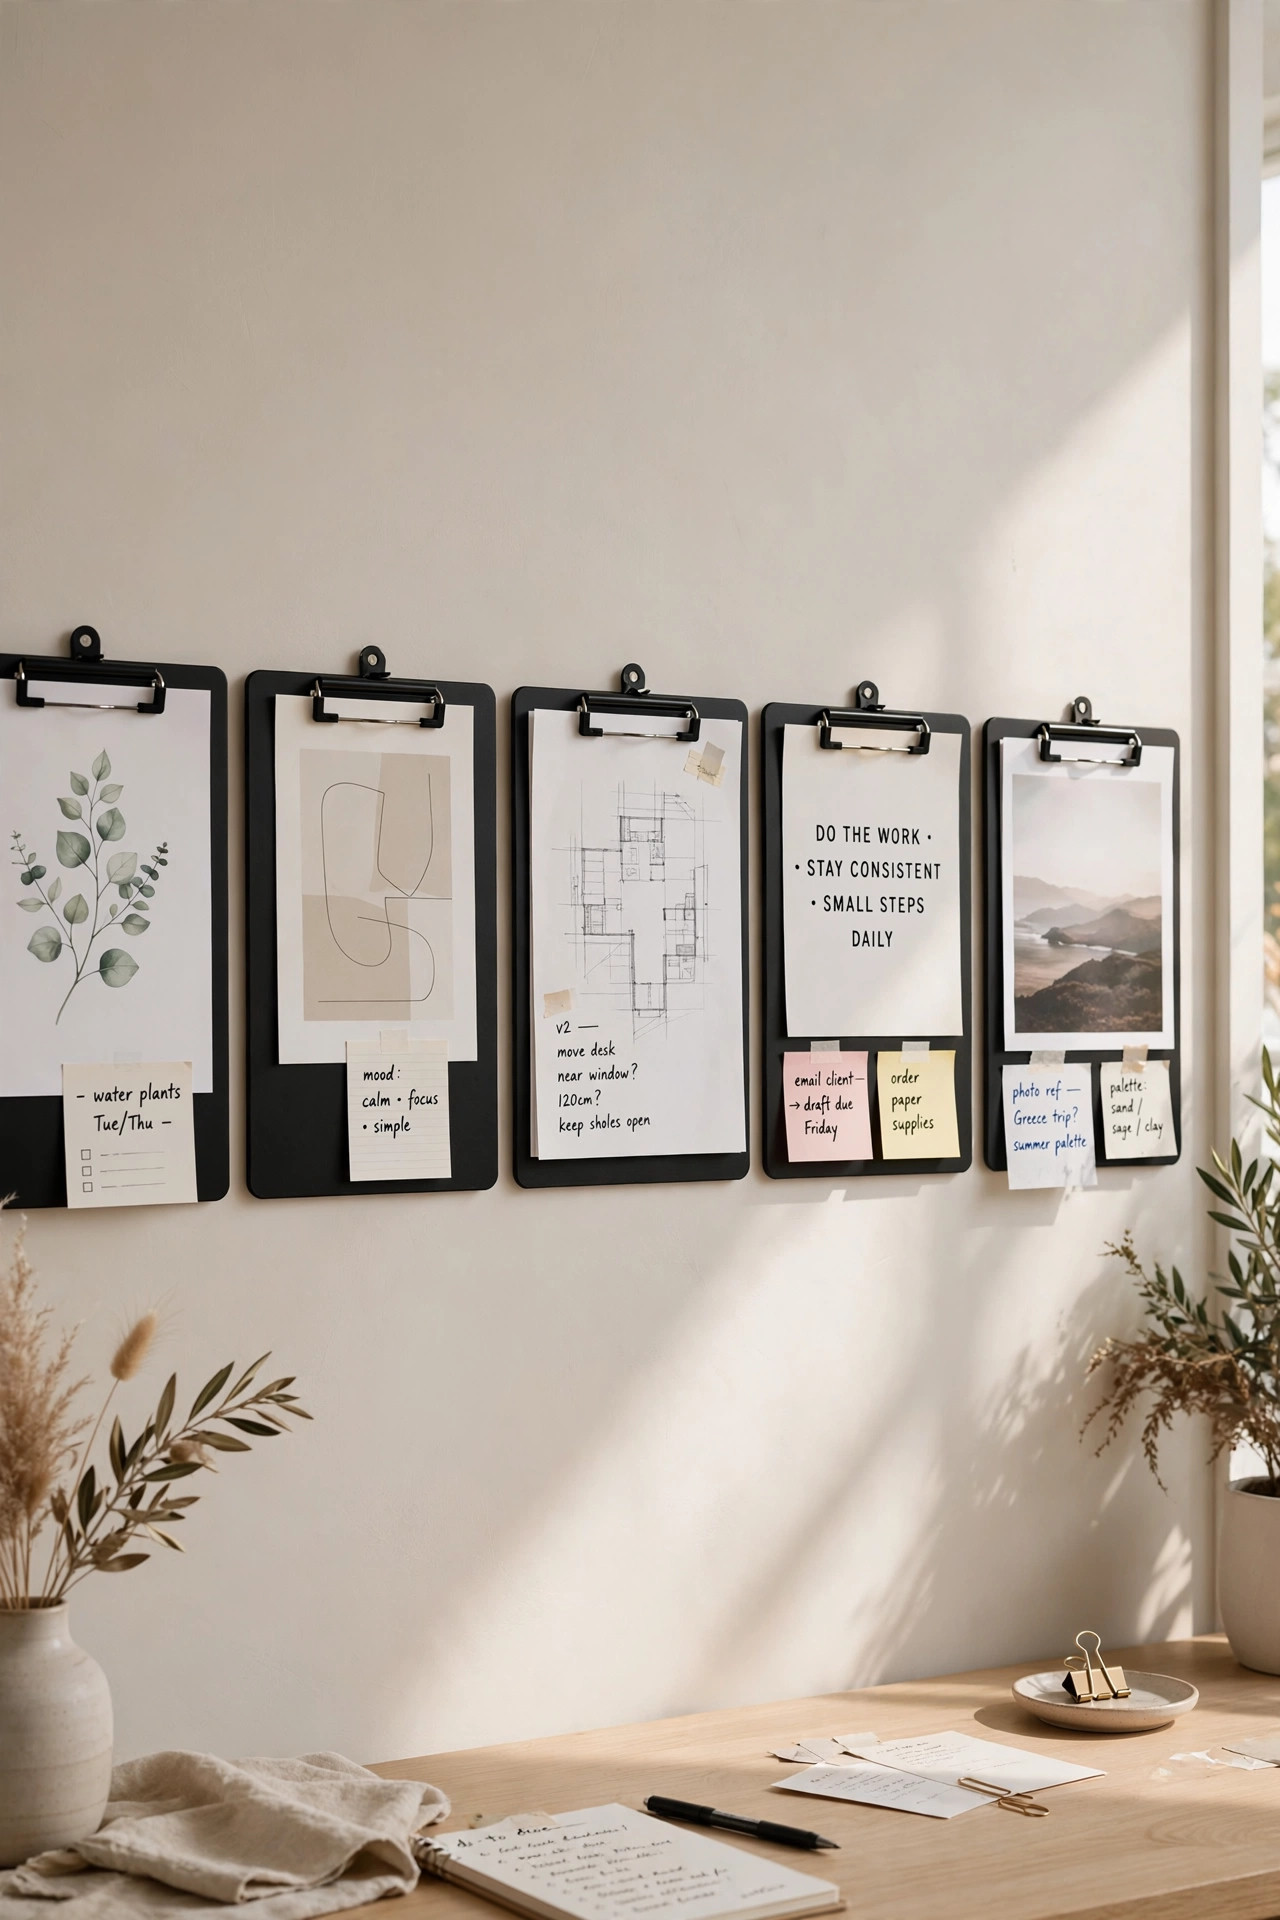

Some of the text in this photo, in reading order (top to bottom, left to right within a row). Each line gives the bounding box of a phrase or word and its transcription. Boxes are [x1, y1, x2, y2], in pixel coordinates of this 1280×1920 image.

[816, 824, 921, 845] DO THE WORK
[807, 858, 941, 880] STAY CONSISTENT
[823, 894, 925, 914] SMALL STEPS
[851, 929, 893, 948] DAILY
[555, 1020, 572, 1035] v2
[557, 1039, 616, 1058] move desk
[363, 1063, 401, 1082] mood:
[557, 1062, 638, 1083] near window?
[794, 1070, 821, 1087] email
[890, 1068, 920, 1085] order
[93, 1081, 181, 1108] water plants
[558, 1088, 602, 1108] 120cm?
[1012, 1079, 1062, 1105] photo ref
[1110, 1077, 1147, 1099] palette:
[362, 1088, 439, 1111] calm focus
[803, 1094, 854, 1116] draft due
[891, 1095, 922, 1113] paper
[1111, 1098, 1134, 1114] sand
[93, 1110, 154, 1136] Tue/Thu
[373, 1115, 411, 1140] simple
[559, 1112, 651, 1138] keep sholes open
[892, 1113, 934, 1136] supplies
[1013, 1106, 1079, 1129] Greece trip?
[804, 1118, 838, 1143] Friday
[1112, 1124, 1132, 1141] sage
[1144, 1118, 1163, 1140] clay
[1013, 1133, 1087, 1157] summer palette
